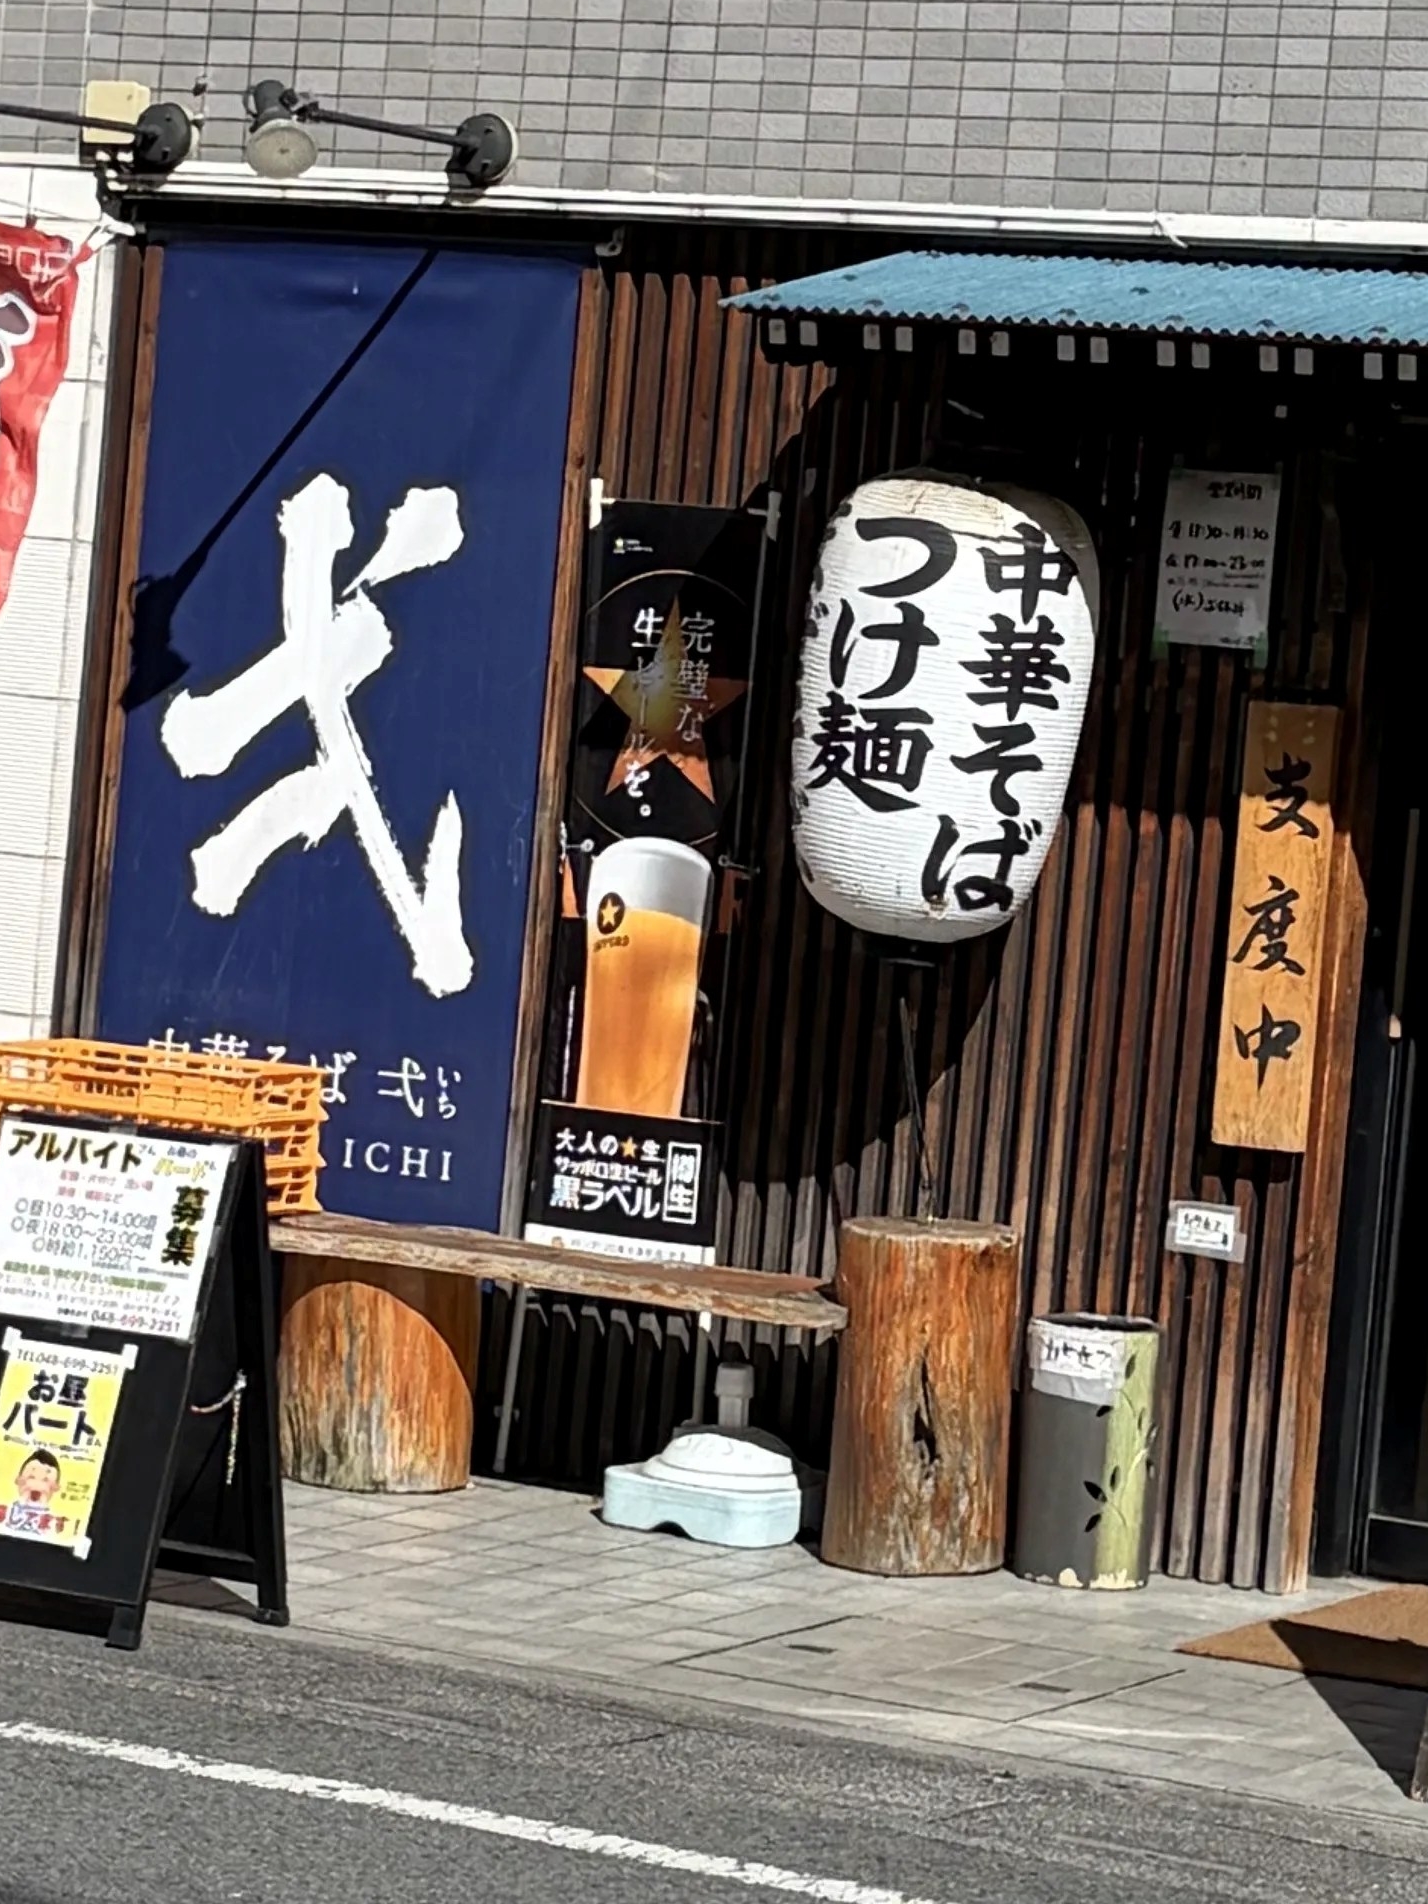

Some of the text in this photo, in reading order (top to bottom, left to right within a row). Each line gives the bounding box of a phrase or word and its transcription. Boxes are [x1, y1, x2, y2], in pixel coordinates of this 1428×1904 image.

[672, 611, 715, 743] 完璧な
[804, 516, 958, 813] つけ麺
[921, 522, 1078, 913] 中華そば
[1231, 752, 1320, 1090] 支度中
[8, 1127, 142, 1173] アルバイト
[342, 1138, 453, 1182] ICHI
[549, 1174, 661, 1219] 黒ラベル
[28, 1369, 90, 1408] お昼
